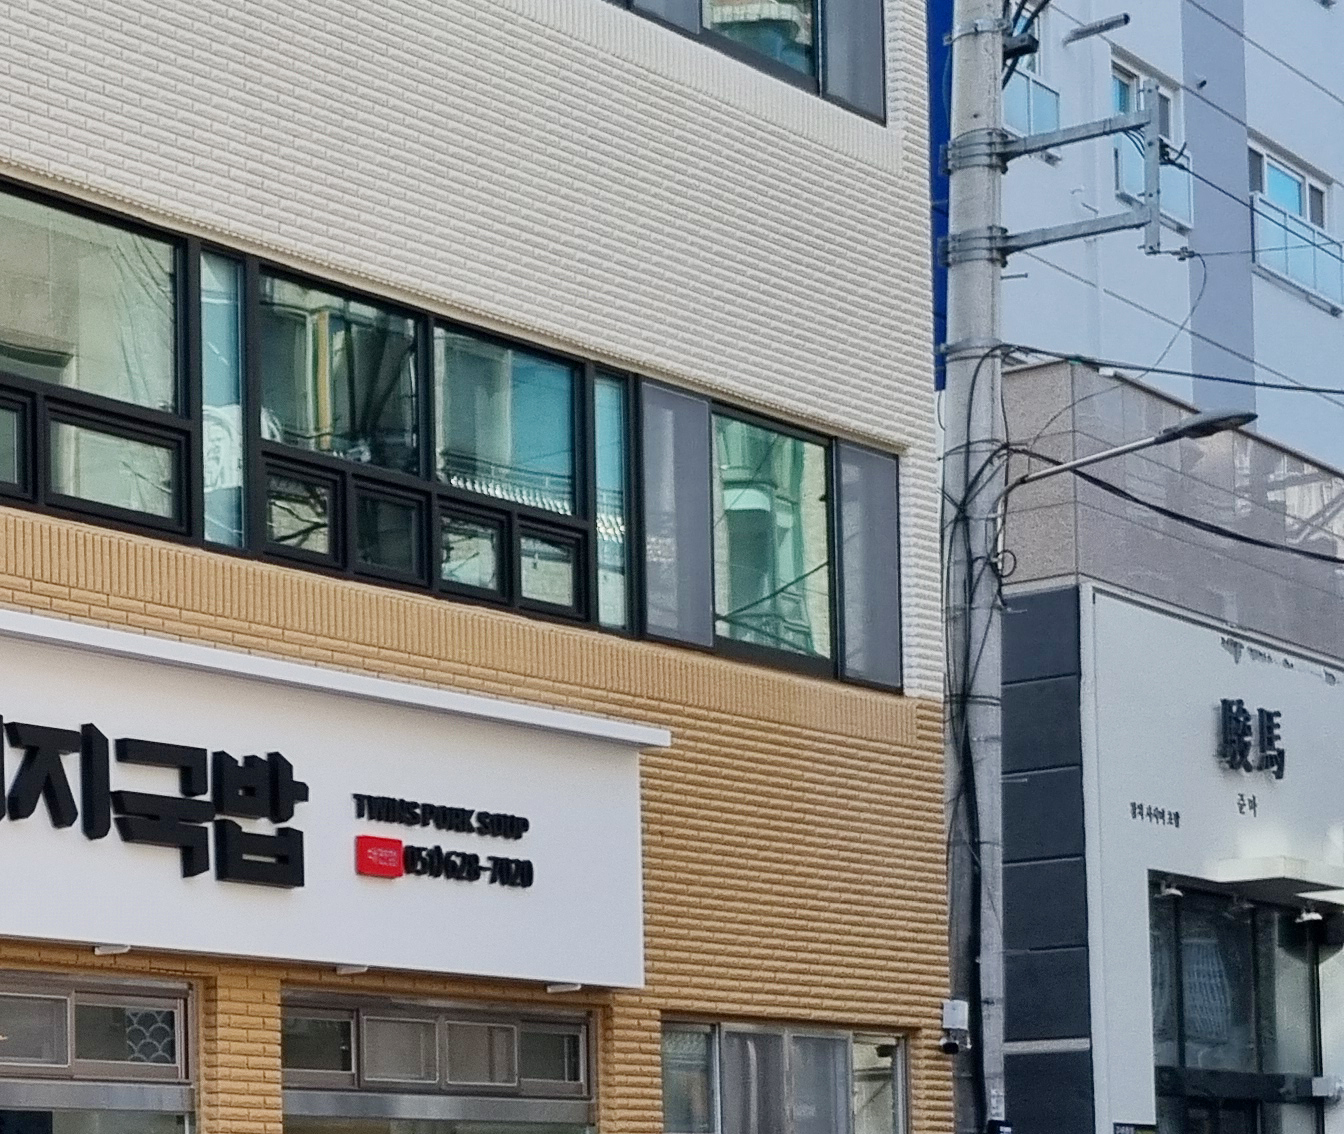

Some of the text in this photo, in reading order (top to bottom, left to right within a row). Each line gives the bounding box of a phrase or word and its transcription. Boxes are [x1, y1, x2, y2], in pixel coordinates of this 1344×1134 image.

[352, 793, 530, 840] TWINS PORK SOUP
